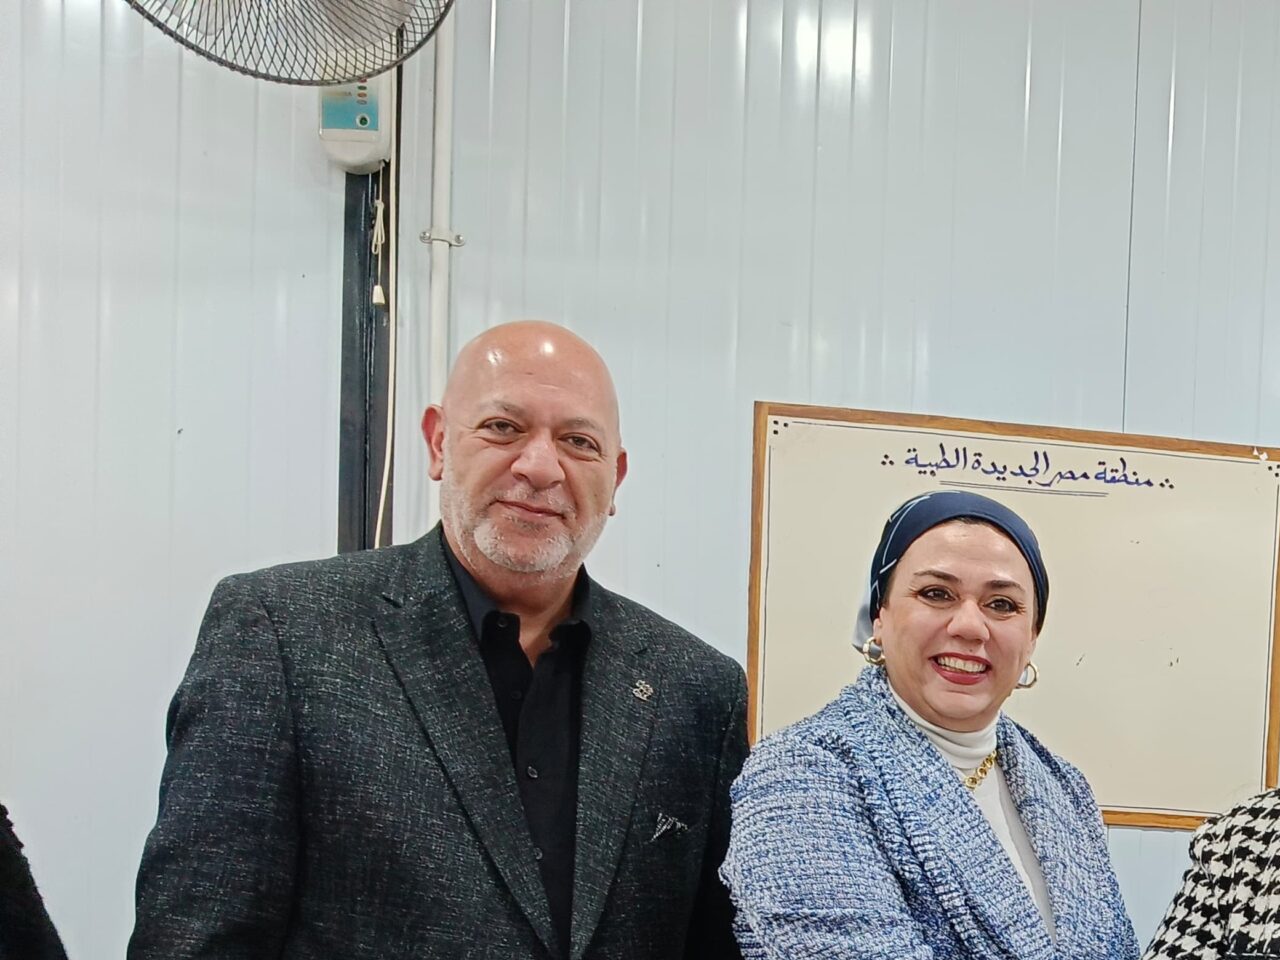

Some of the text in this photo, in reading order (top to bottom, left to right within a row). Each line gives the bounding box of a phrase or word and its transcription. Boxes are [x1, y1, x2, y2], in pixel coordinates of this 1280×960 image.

[904, 442, 1154, 487] منطقة مصر الجديدة الطبية
